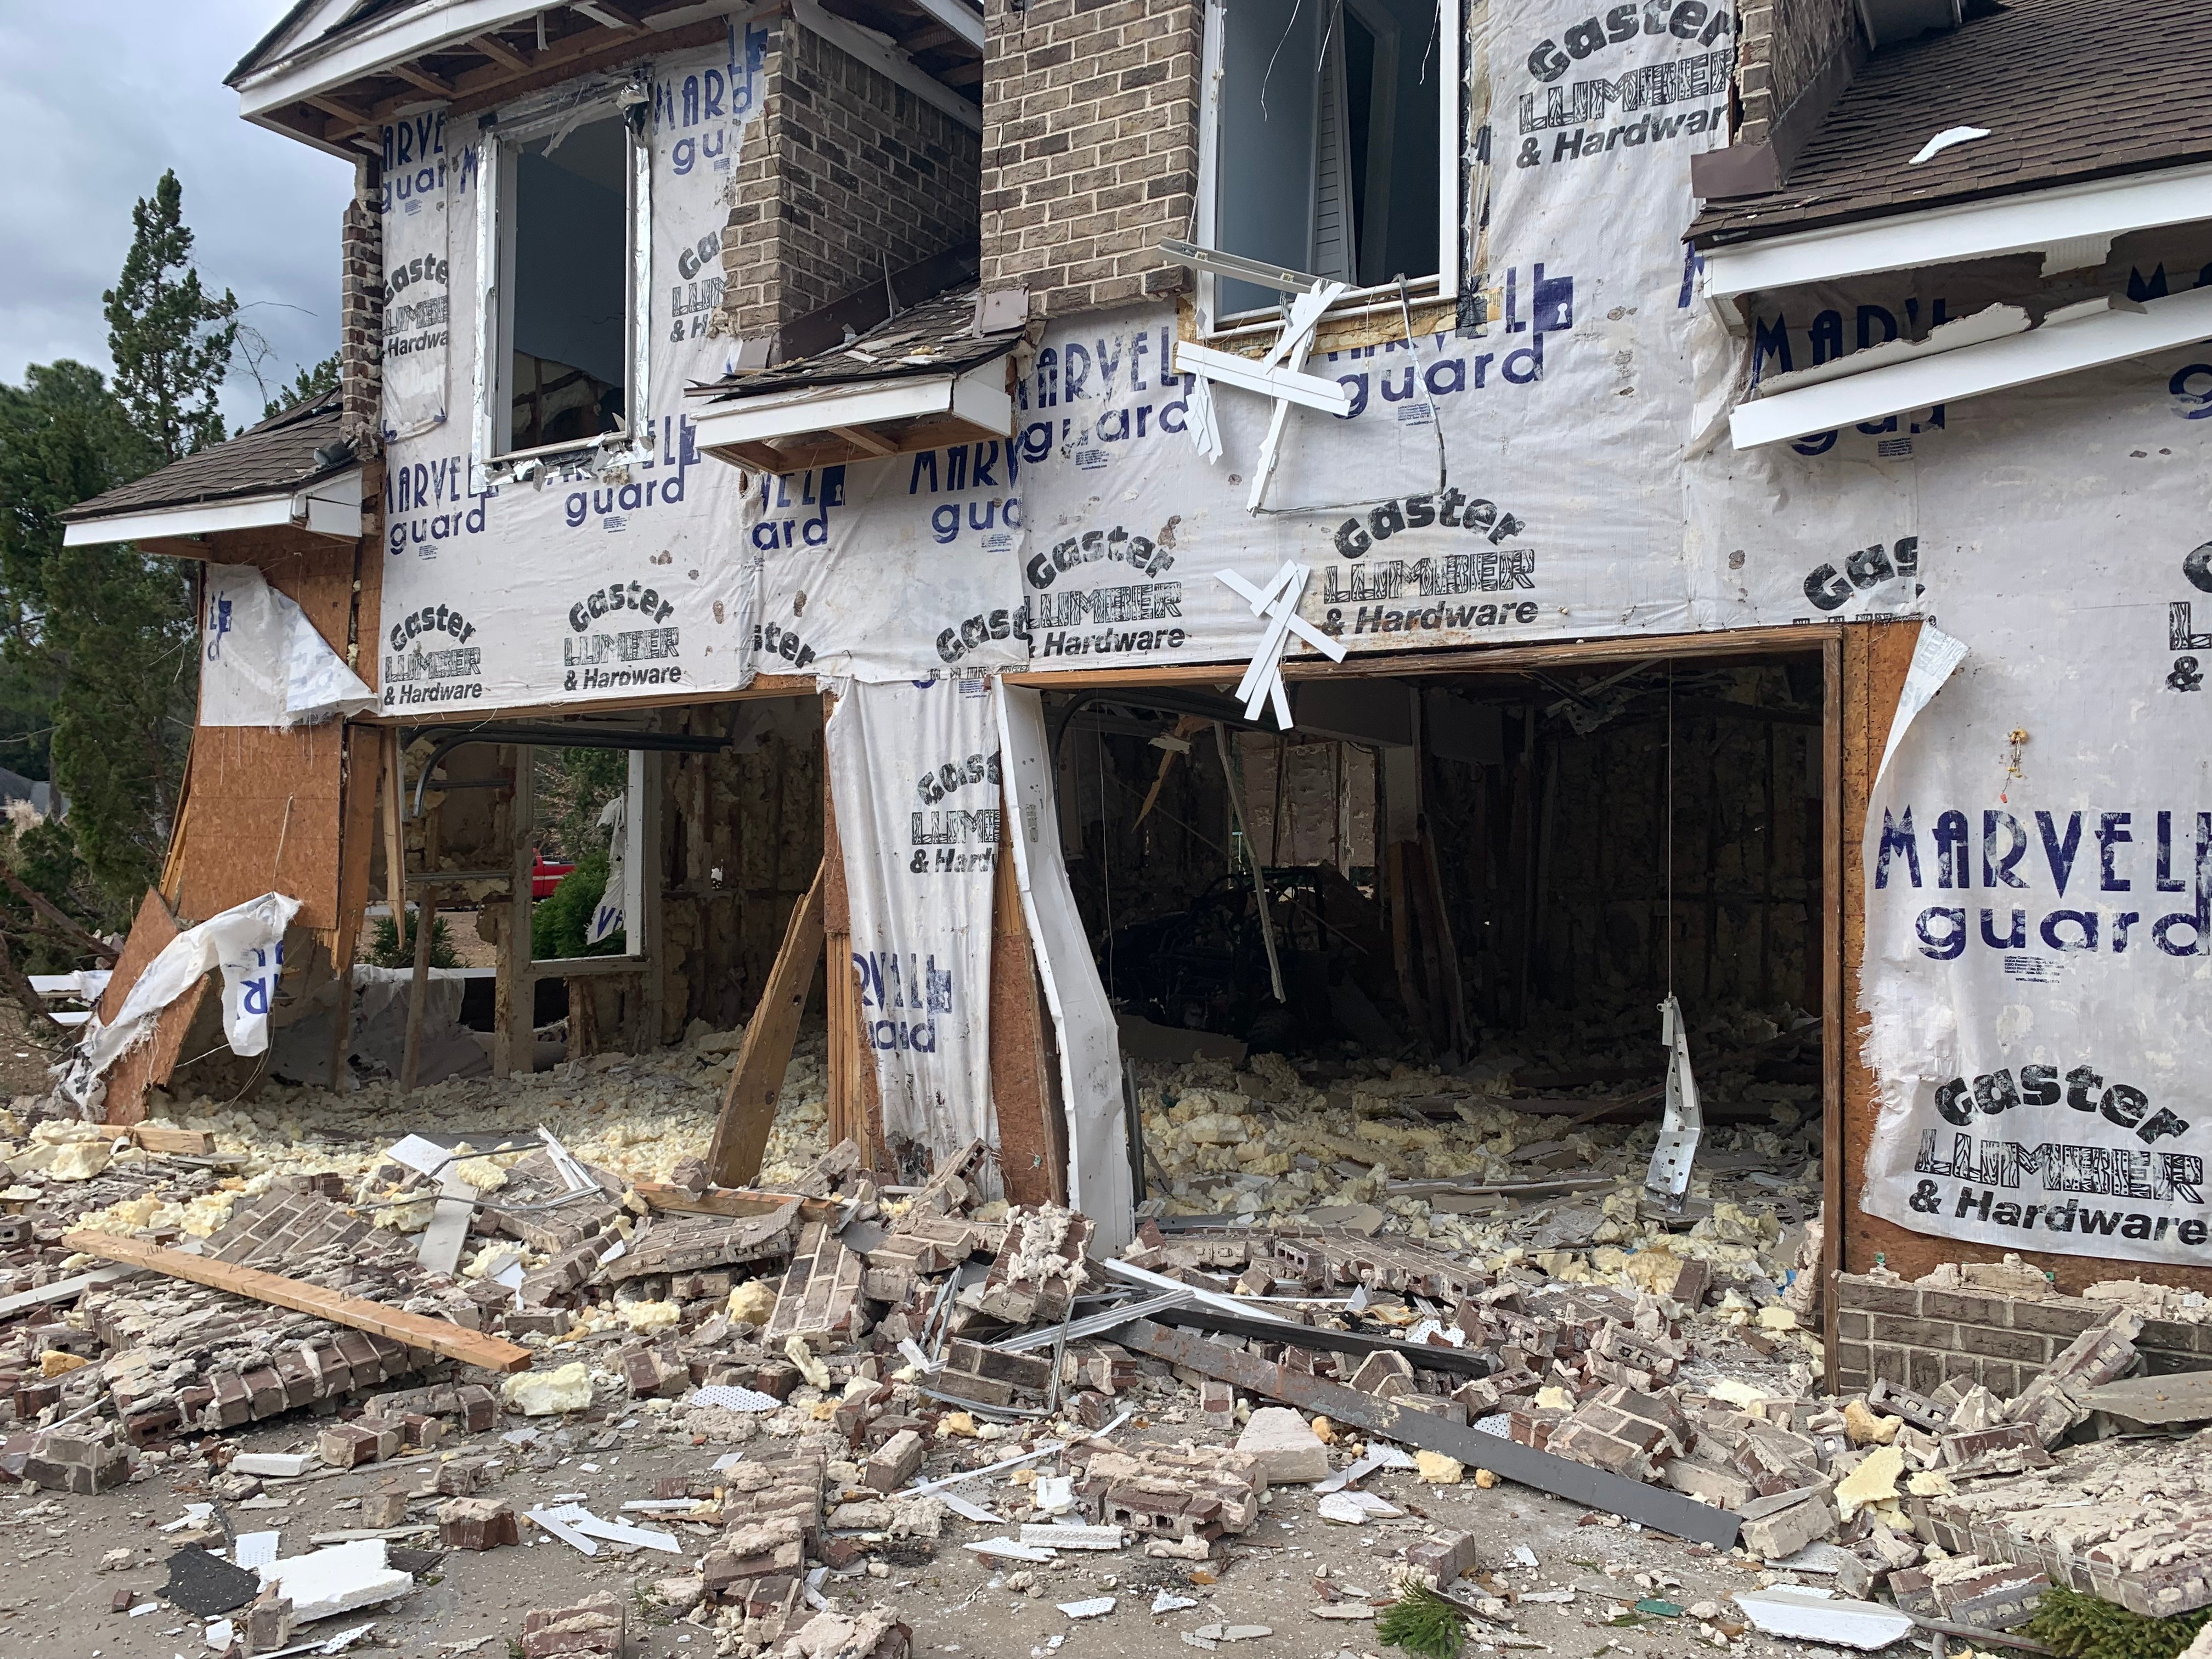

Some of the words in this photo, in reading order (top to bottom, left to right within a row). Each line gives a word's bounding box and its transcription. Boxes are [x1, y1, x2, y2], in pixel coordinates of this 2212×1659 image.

[653, 64, 734, 136] MAR
[678, 226, 726, 280] Ga
[565, 466, 685, 527] guard
[1334, 487, 1526, 558] Gaster
[1027, 526, 1175, 590] Gaster
[1324, 549, 1535, 604] LUMBER
[390, 603, 476, 652] Gaster
[569, 579, 674, 633] Gaster
[1355, 601, 1538, 635] Hardware
[385, 647, 481, 683] LUMBER
[564, 627, 679, 666] LUMBER
[1044, 628, 1186, 657] Hardware
[399, 682, 482, 704] Hardware
[583, 665, 682, 690] Hardware
[1915, 900, 2211, 961] guard
[1934, 1064, 2190, 1144] Gaster
[1914, 1128, 2204, 1205] LUMBER
[1954, 1187, 2208, 1246] Hardware
